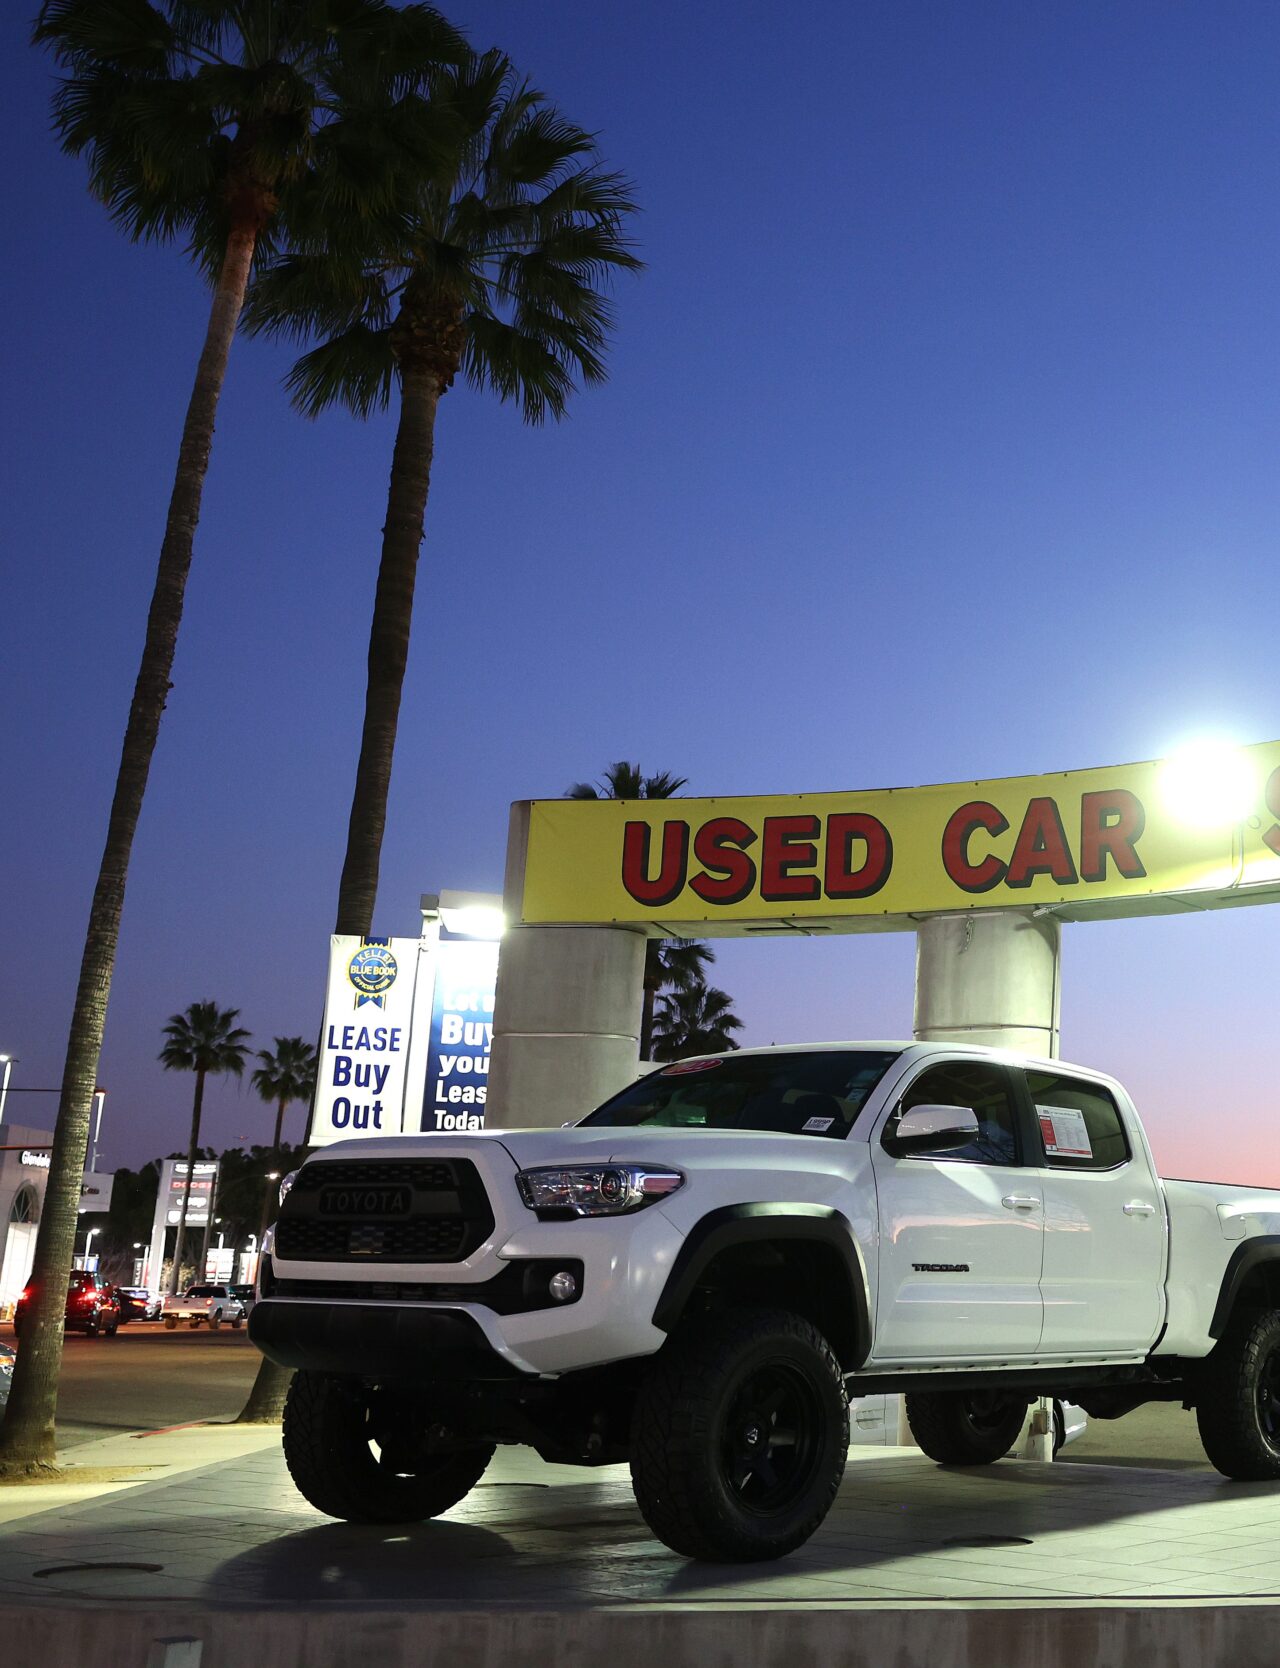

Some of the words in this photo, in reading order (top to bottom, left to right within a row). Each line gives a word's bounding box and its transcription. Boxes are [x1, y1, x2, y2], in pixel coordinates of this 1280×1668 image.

[621, 812, 893, 907] USED
[941, 788, 1147, 894] CAR
[356, 949, 396, 964] KELLEY
[350, 965, 373, 975] BLUE
[373, 966, 396, 976] BOOK
[327, 1025, 402, 1052] LEASE
[333, 1055, 391, 1096] Buy
[435, 1079, 488, 1104] Leas
[331, 1096, 383, 1130] Out
[326, 1191, 404, 1212] TOYOTA
[911, 1263, 970, 1272] TACOMA
